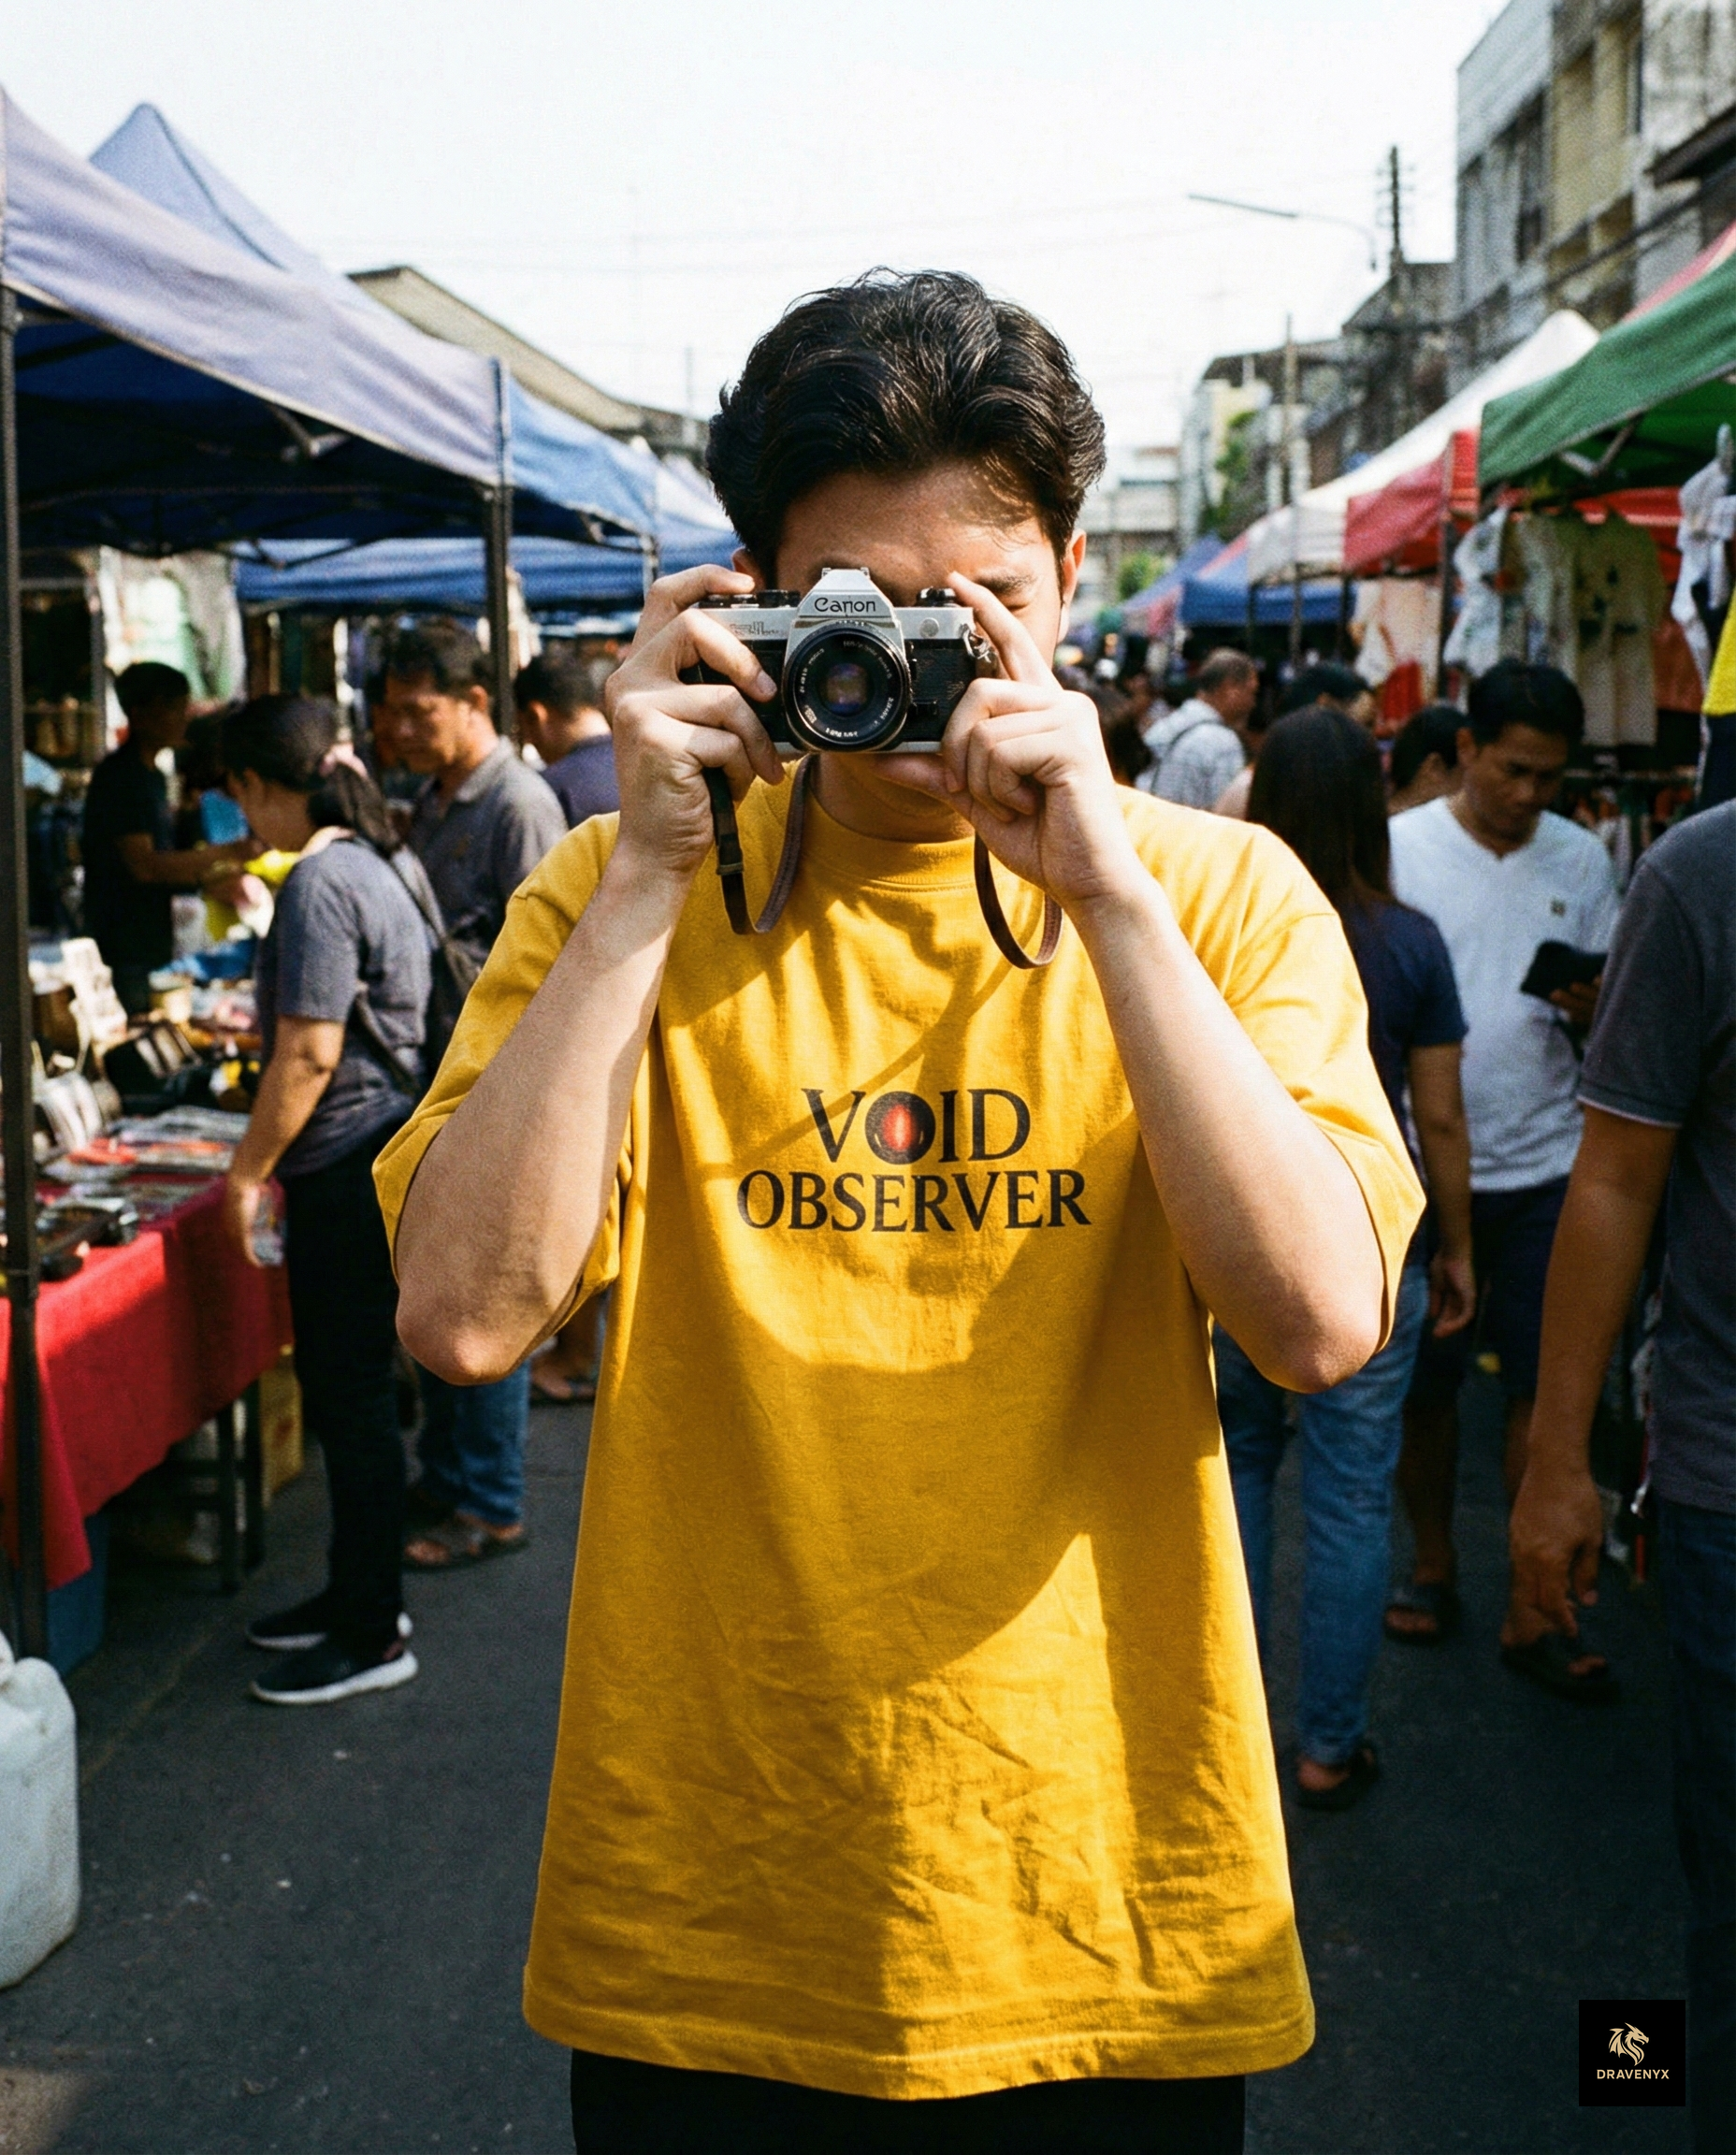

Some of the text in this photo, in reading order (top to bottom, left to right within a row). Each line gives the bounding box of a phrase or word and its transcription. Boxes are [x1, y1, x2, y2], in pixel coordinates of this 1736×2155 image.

[814, 597, 875, 613] Canon
[801, 1088, 1030, 1165] VOID
[736, 1168, 1092, 1234] OBSERVER
